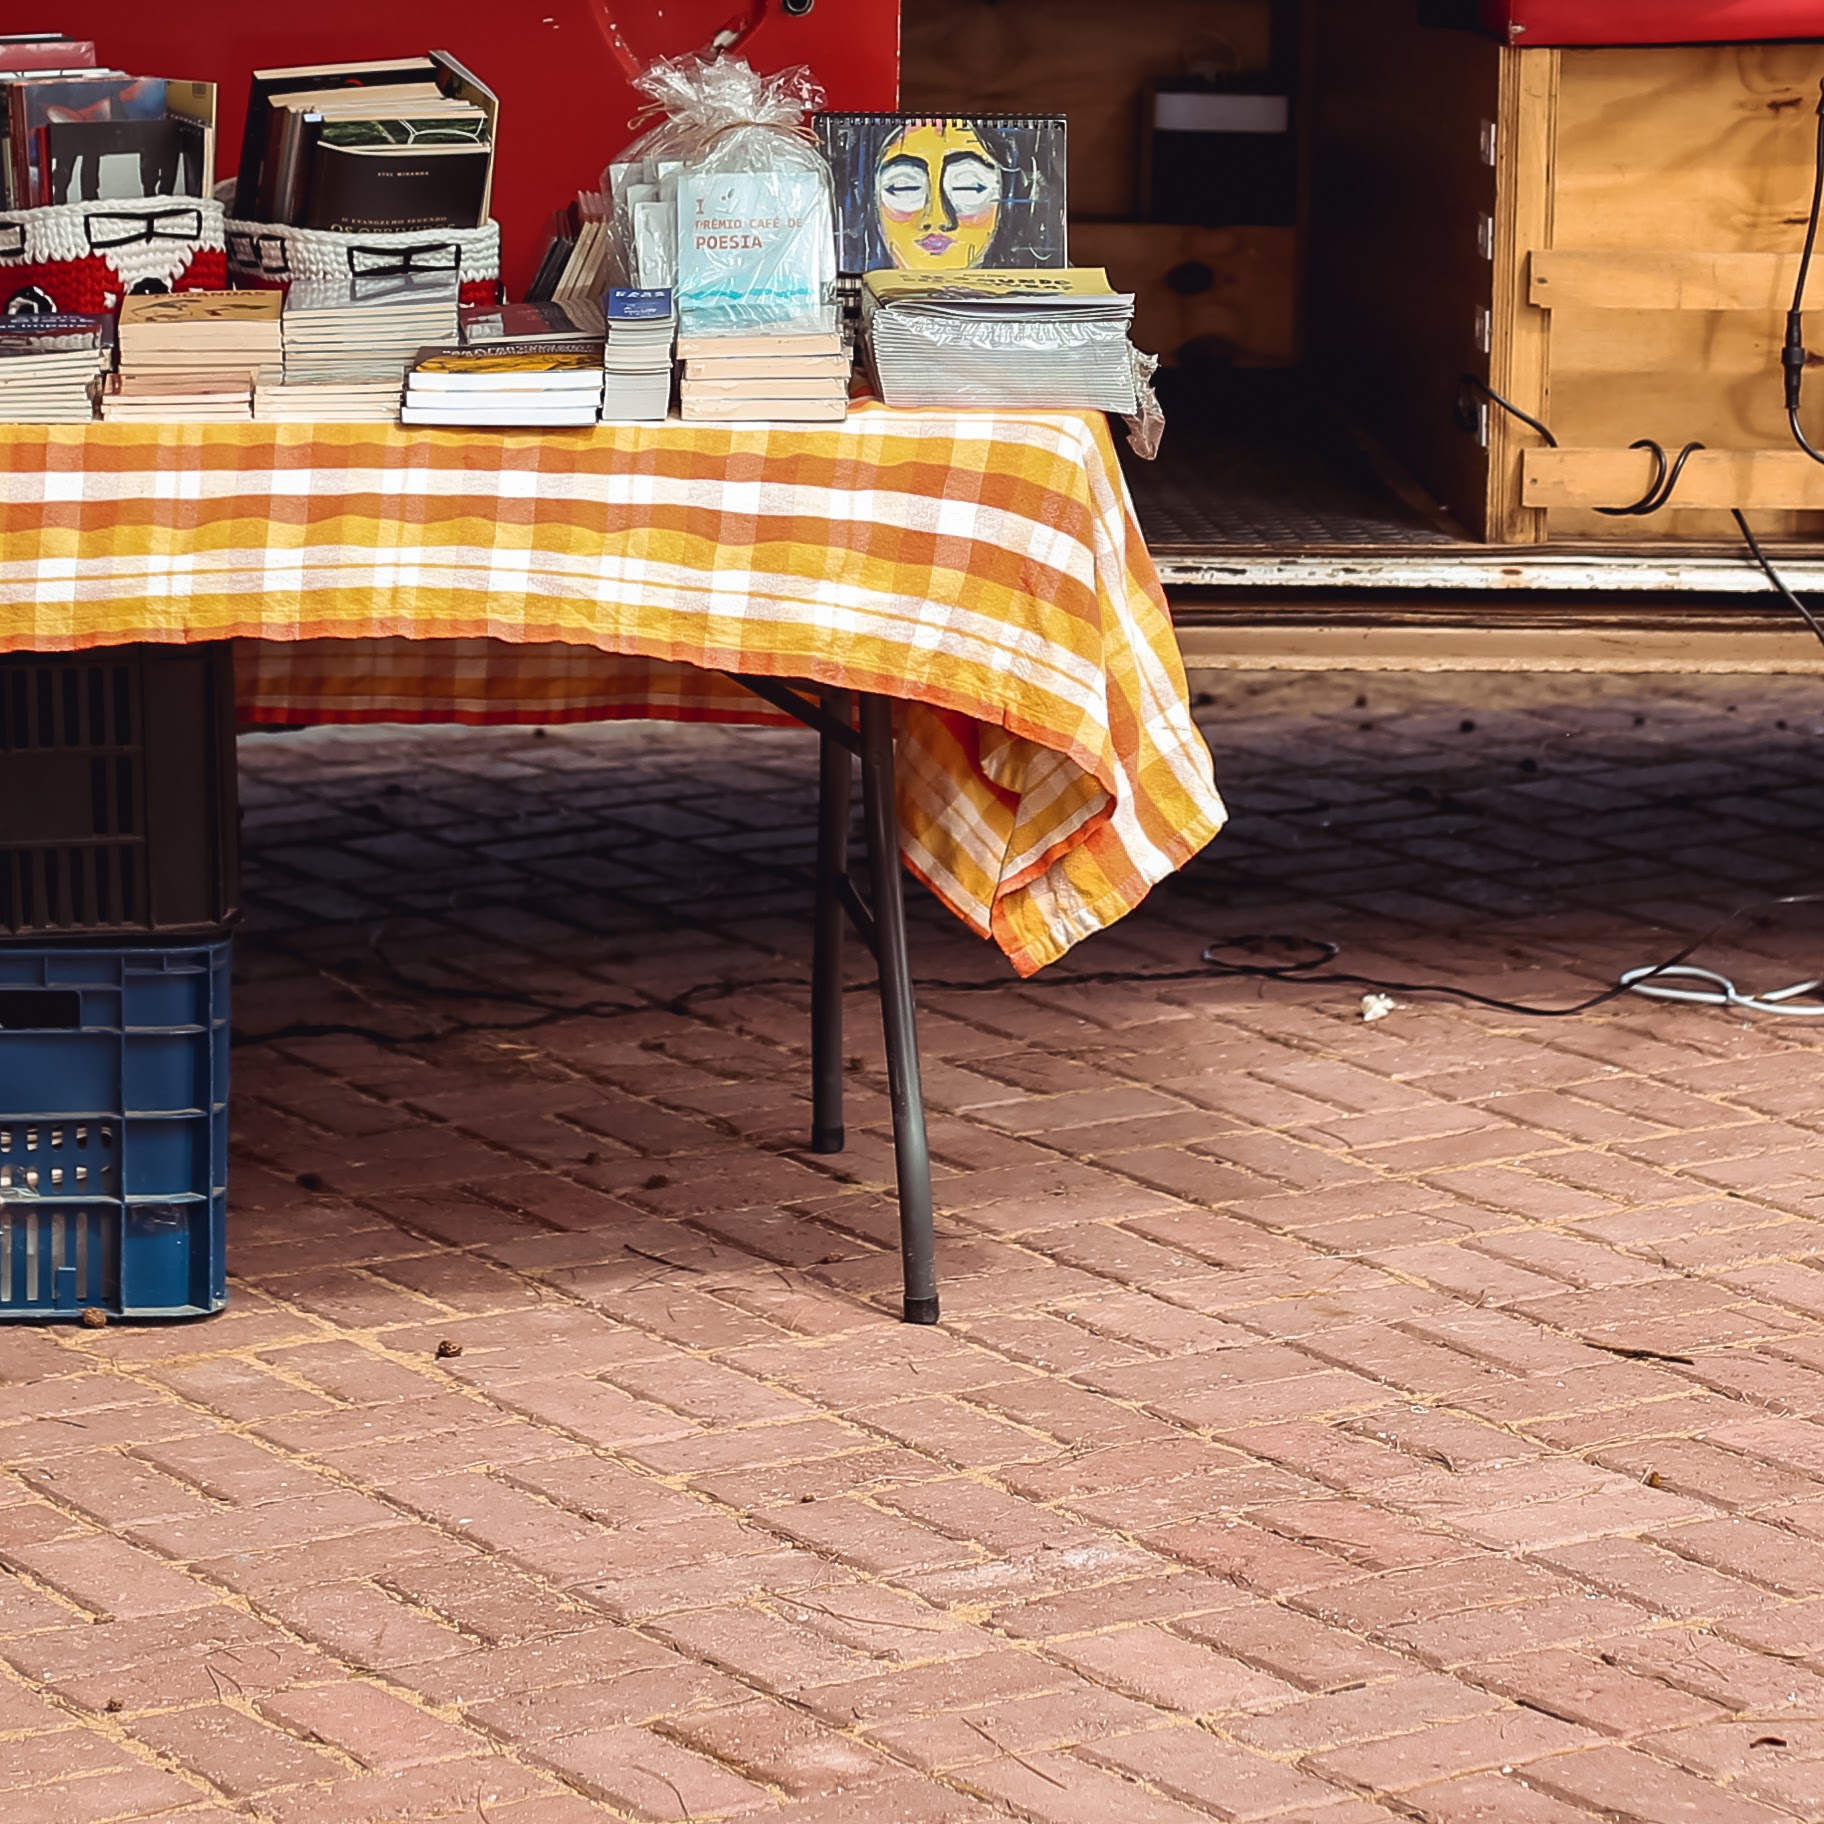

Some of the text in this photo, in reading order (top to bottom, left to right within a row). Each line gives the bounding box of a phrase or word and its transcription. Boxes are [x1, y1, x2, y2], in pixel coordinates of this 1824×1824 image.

[695, 198, 705, 215] I
[695, 216, 803, 230] PRÊMIO CAFÉ DE
[695, 235, 763, 250] POESIA
